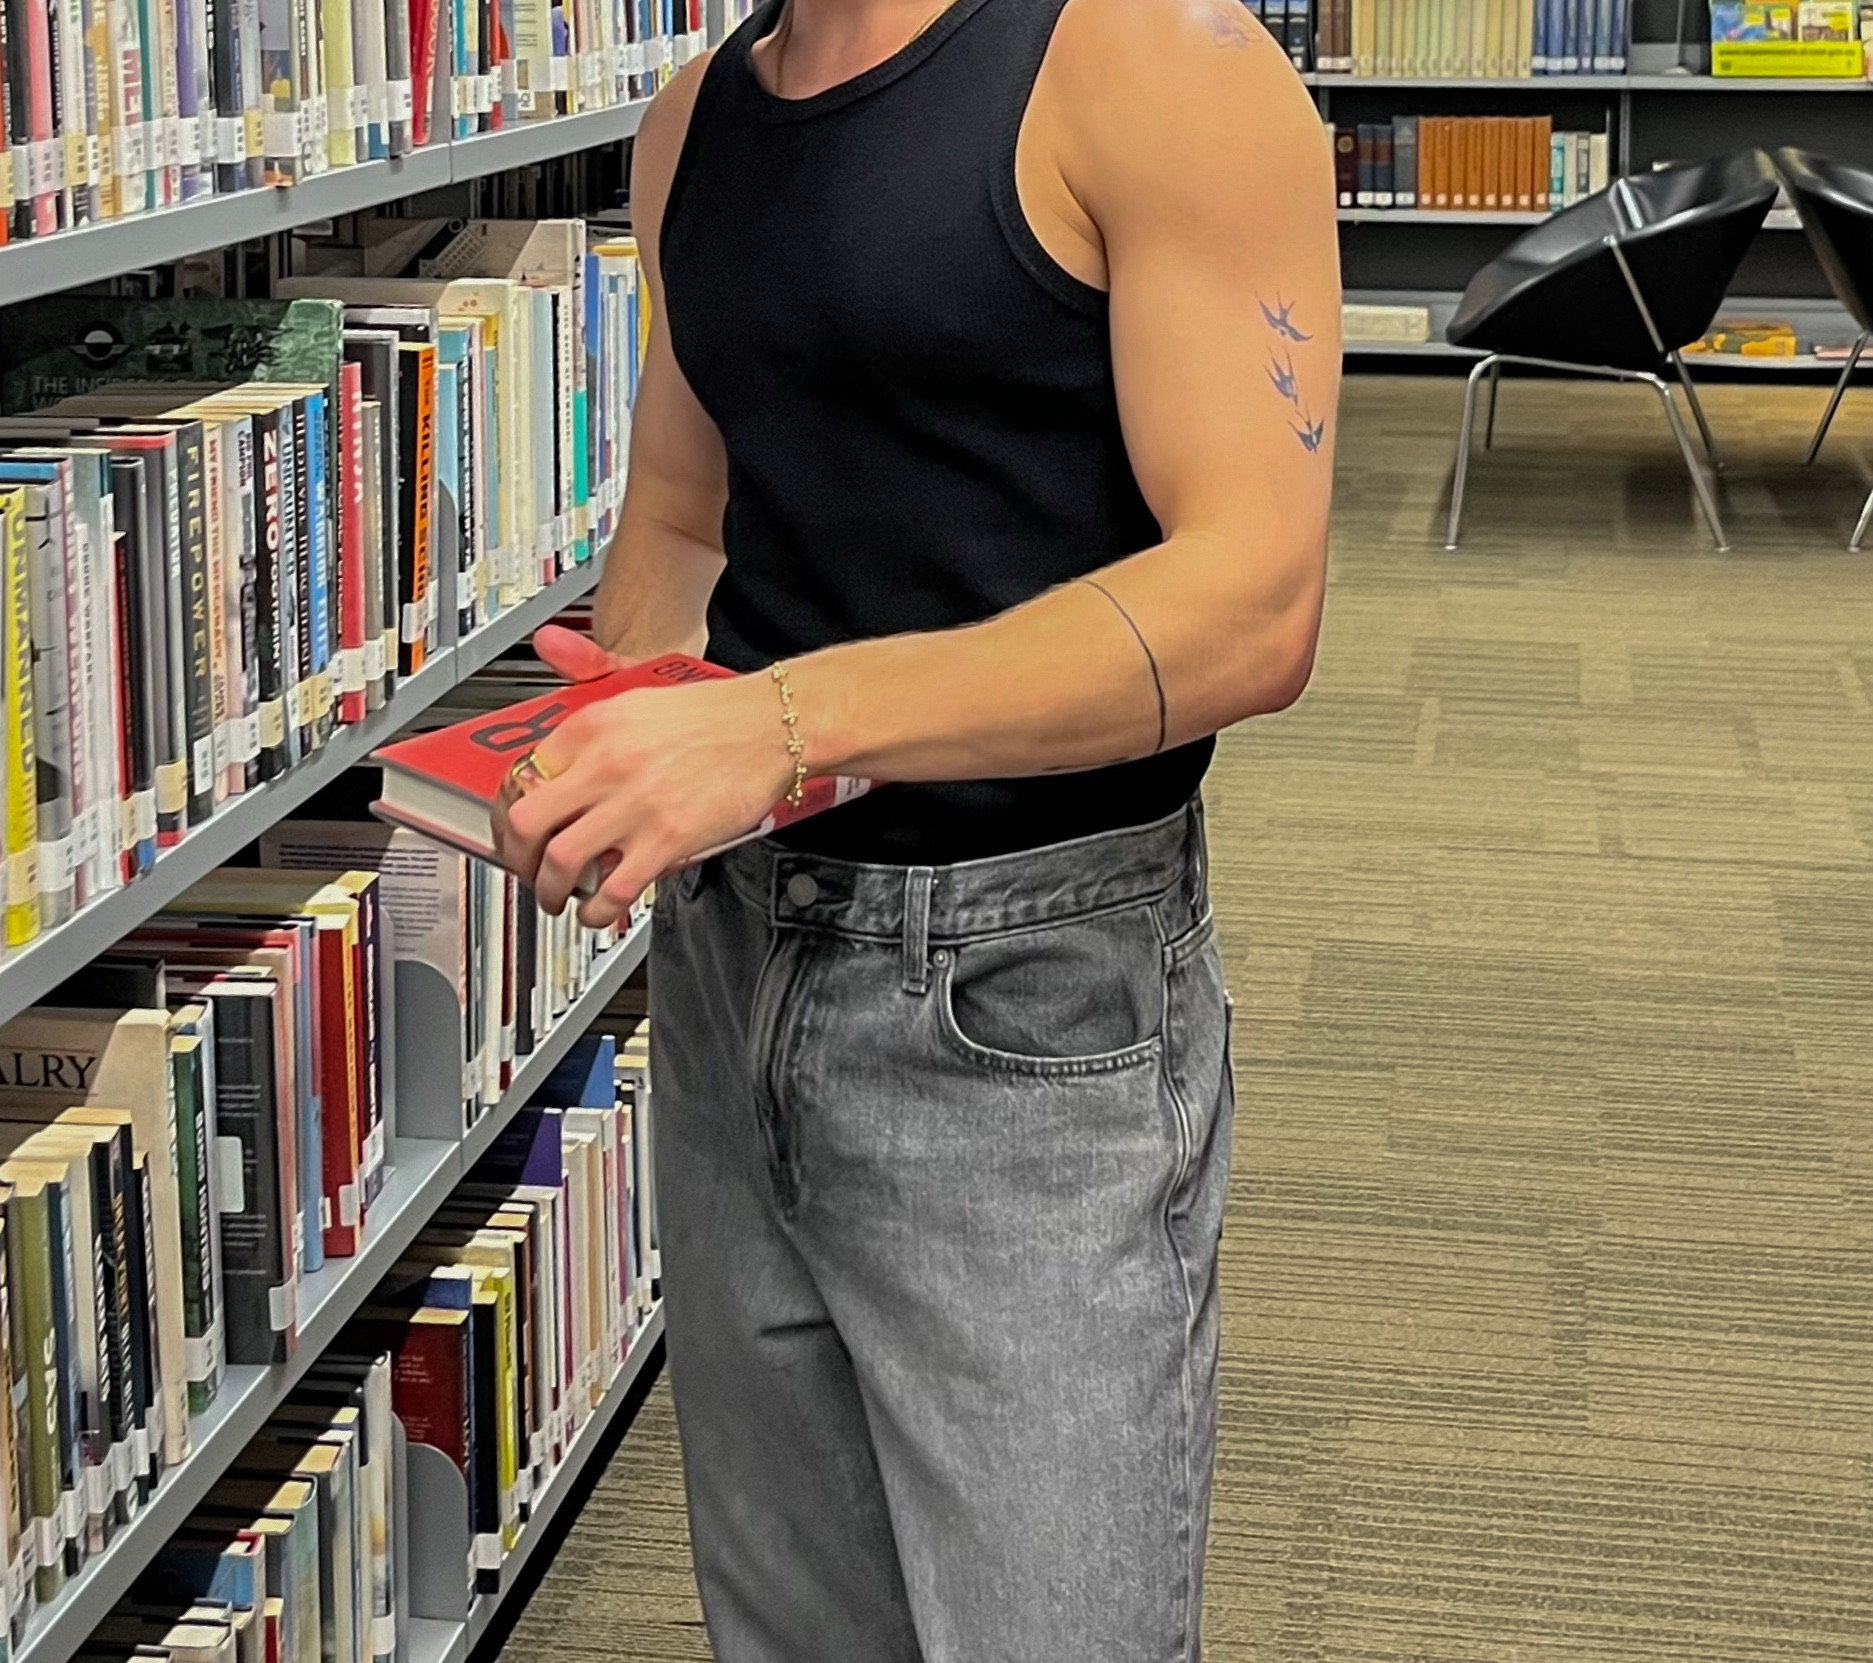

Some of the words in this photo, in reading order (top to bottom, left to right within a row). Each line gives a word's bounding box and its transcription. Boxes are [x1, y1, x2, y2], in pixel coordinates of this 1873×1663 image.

[33, 375, 69, 395] THE
[238, 430, 246, 488] CAMPION
[261, 428, 280, 552] ZERO
[281, 441, 296, 577] UNDAUNTED
[82, 542, 90, 596] DRONE
[186, 445, 208, 678] FIREPOWER
[270, 551, 282, 671] FOOTPRINT
[12, 506, 35, 776] UNMANNED
[84, 602, 93, 685] WARFARE
[43, 1327, 58, 1435] SAS
